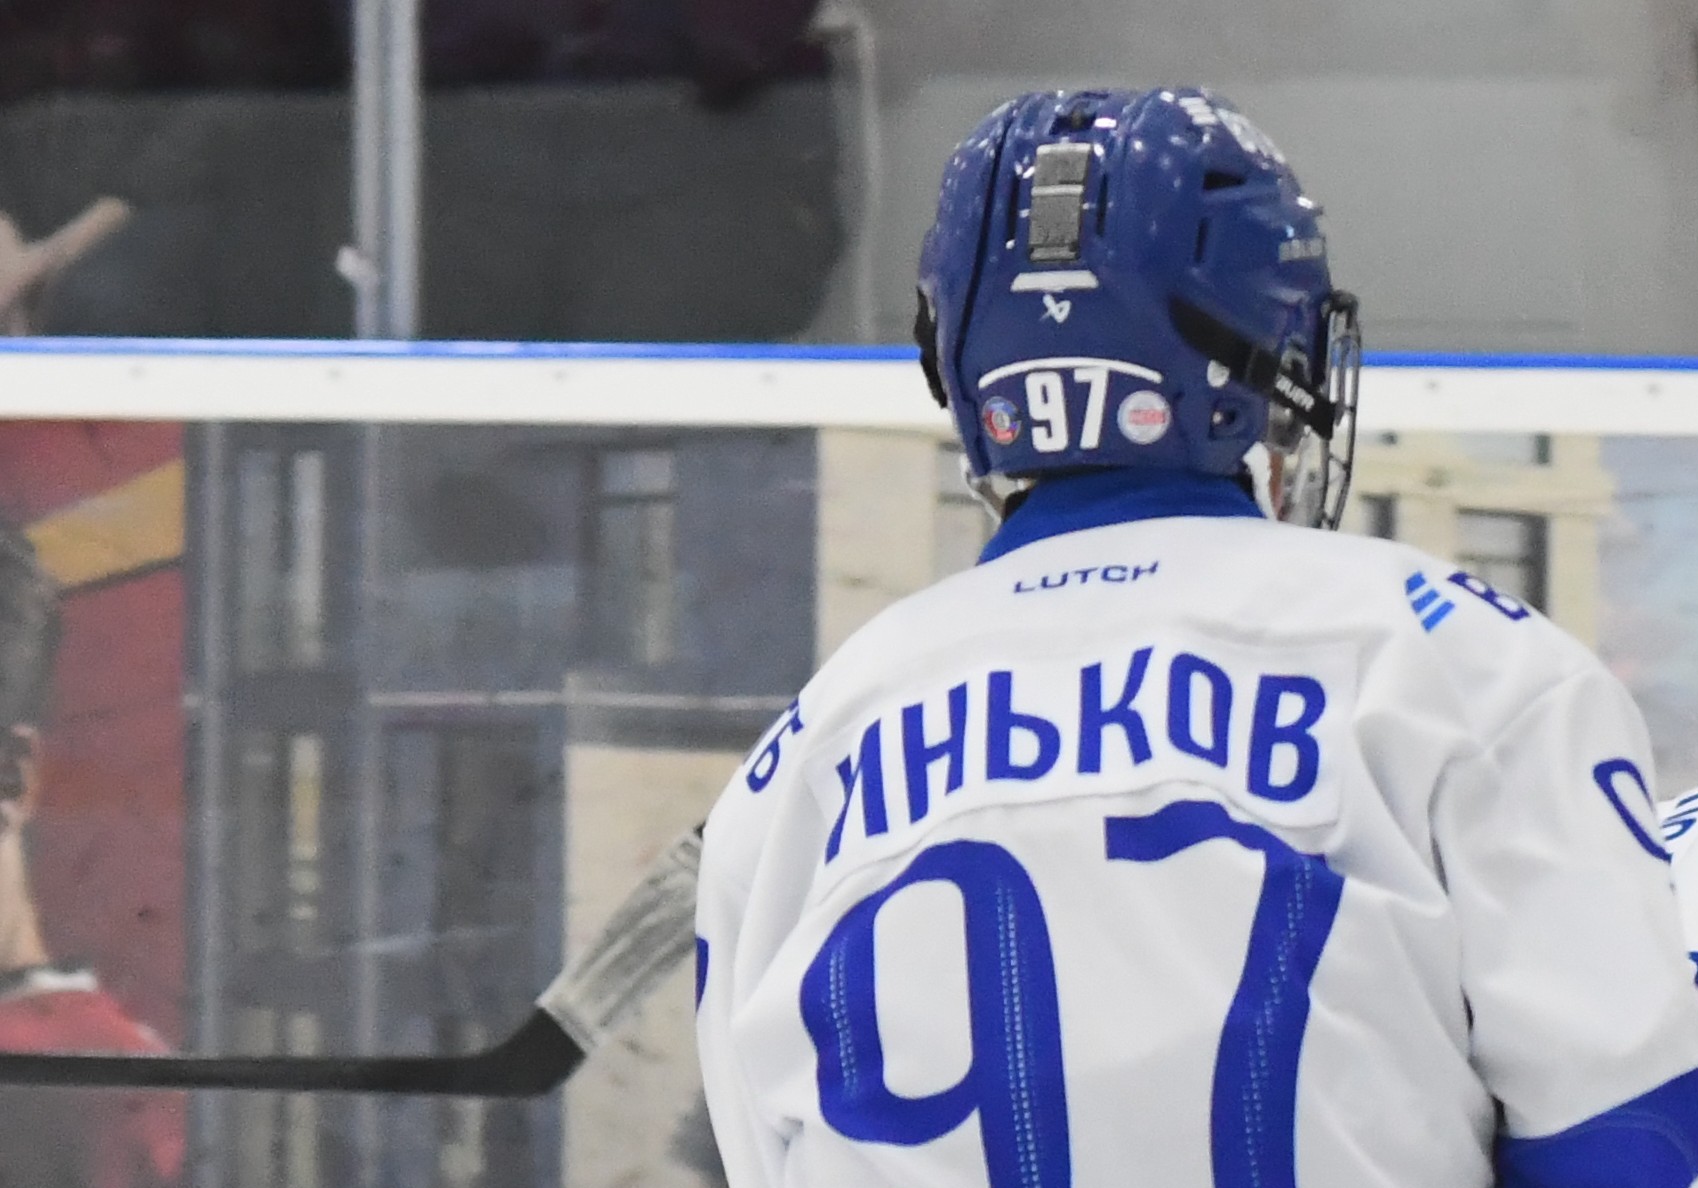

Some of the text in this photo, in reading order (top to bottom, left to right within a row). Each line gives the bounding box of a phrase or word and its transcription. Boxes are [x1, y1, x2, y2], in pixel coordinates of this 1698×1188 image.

[1025, 366, 1110, 453] 97
[1013, 561, 1160, 594] LUTCH
[824, 645, 1327, 866] ИНЬКОВ
